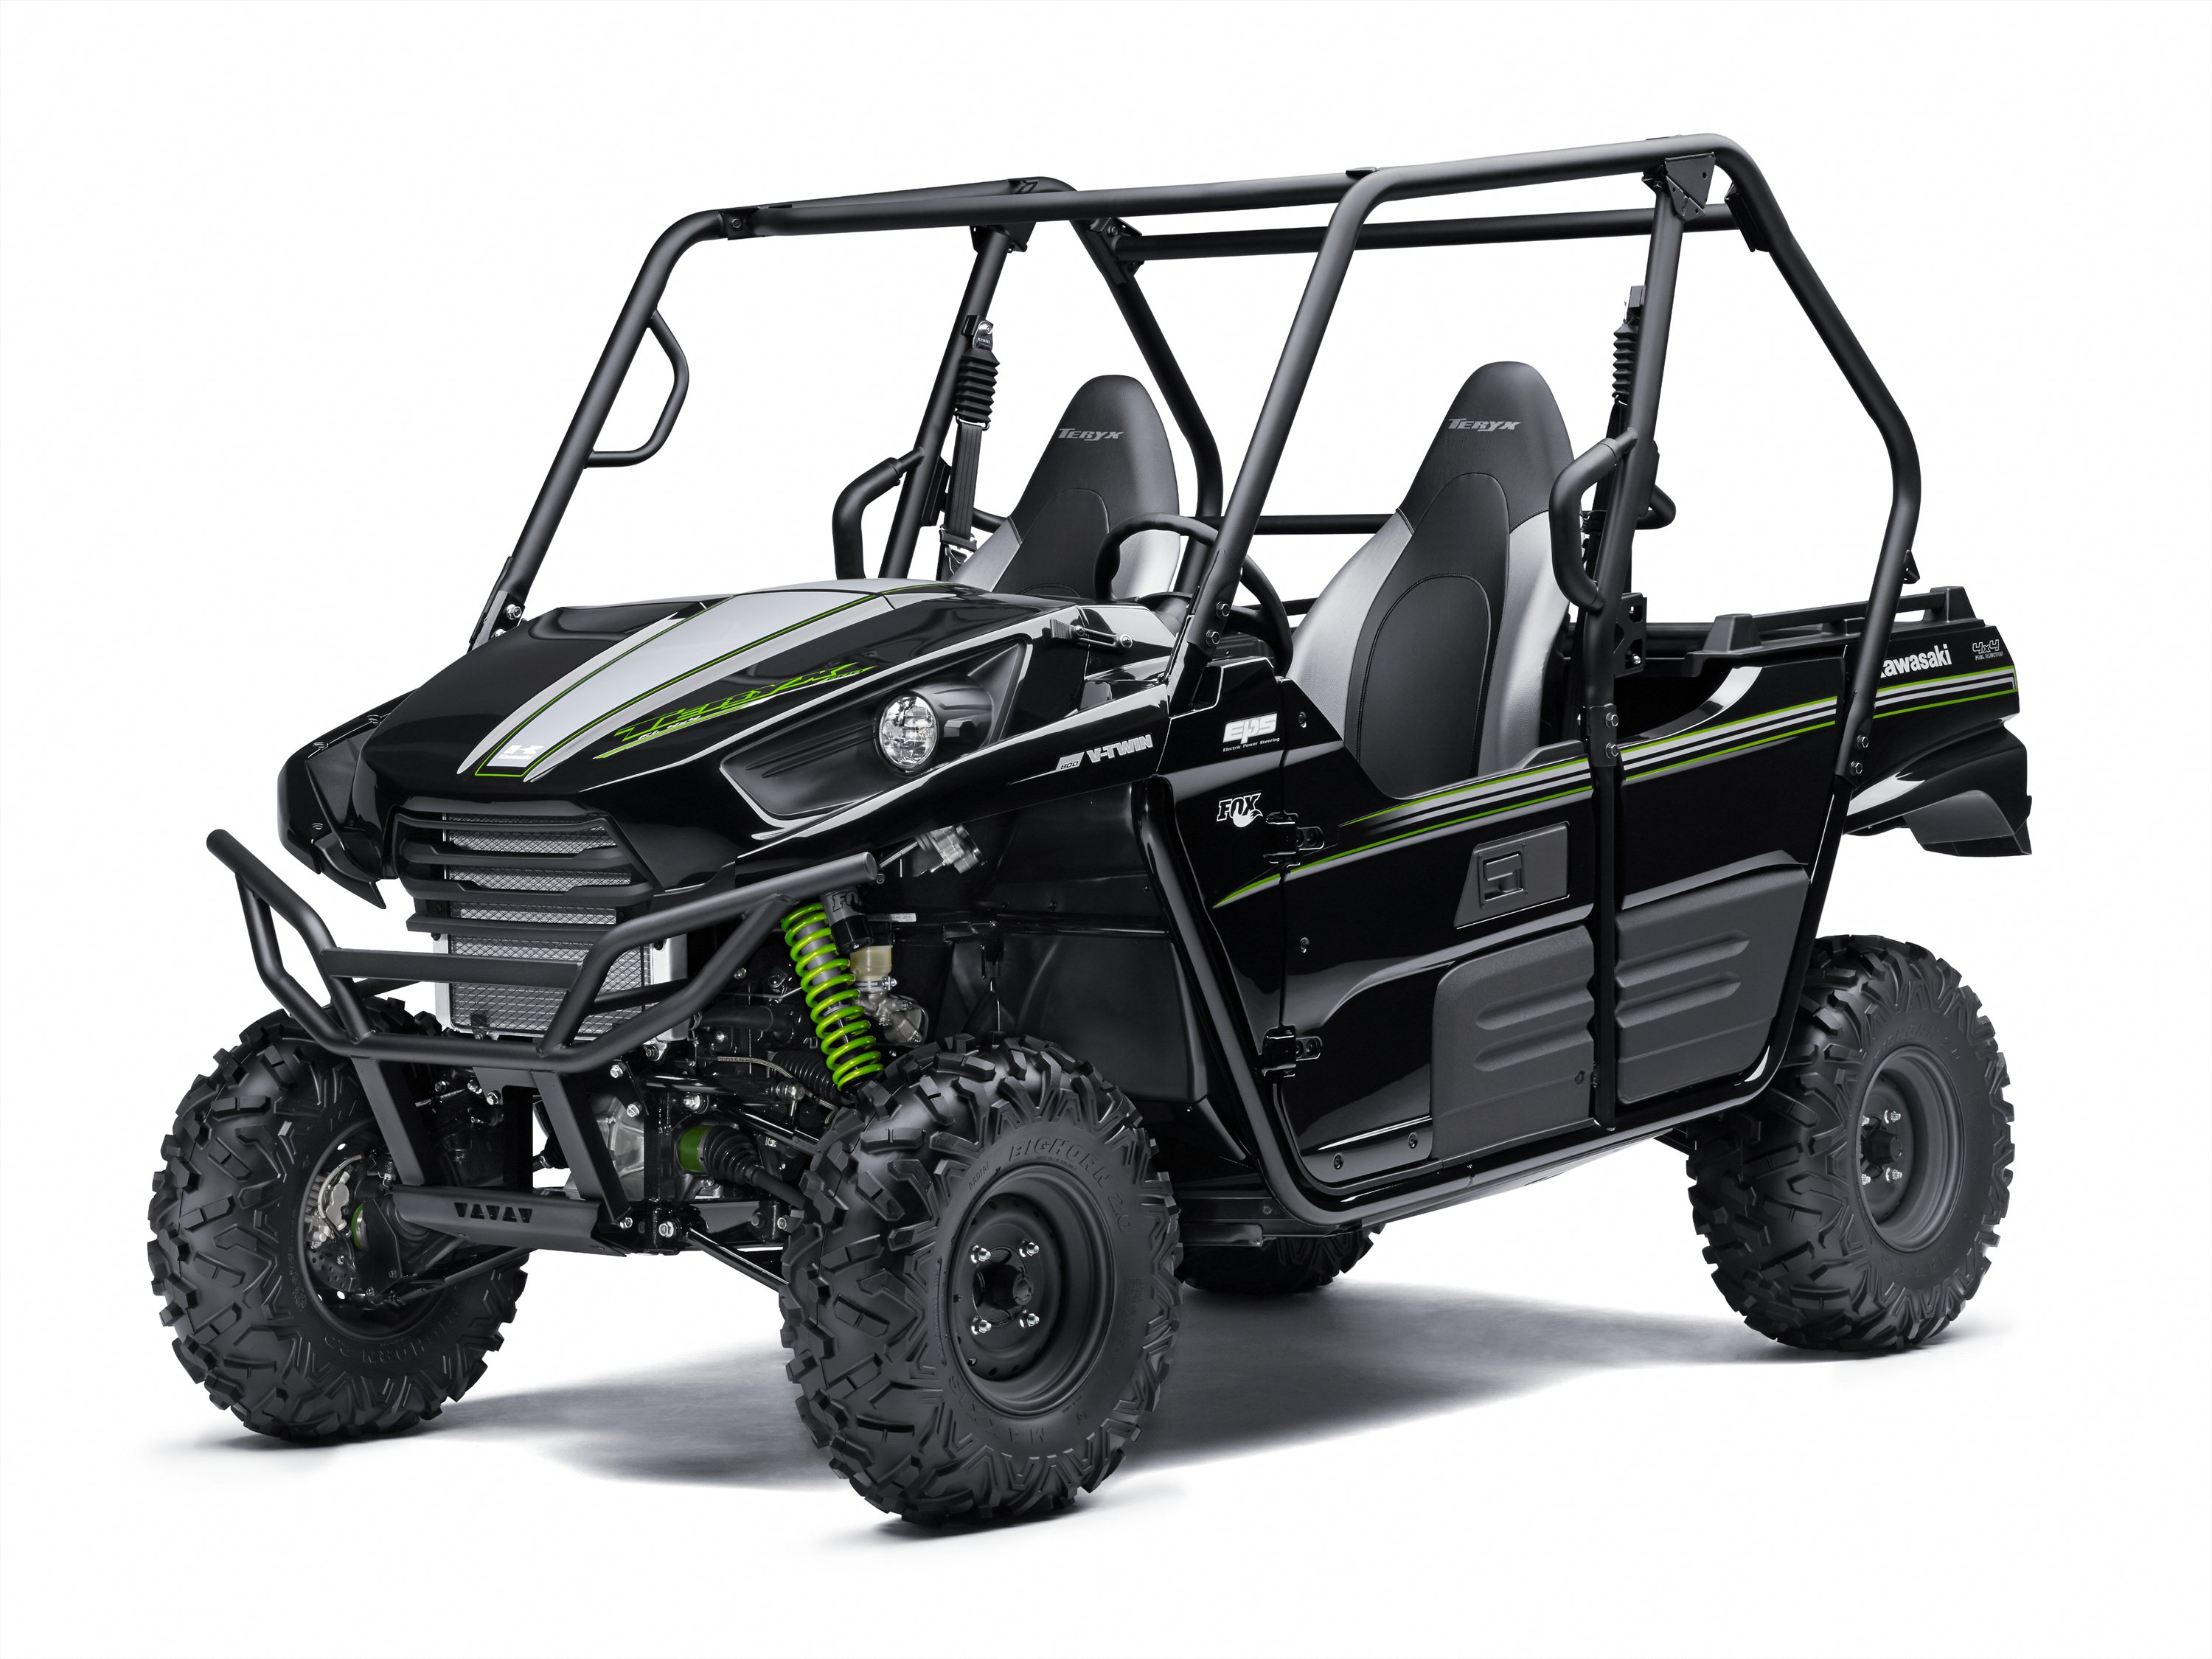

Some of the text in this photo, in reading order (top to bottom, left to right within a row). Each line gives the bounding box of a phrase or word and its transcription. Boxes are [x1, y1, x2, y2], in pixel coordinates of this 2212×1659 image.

[1972, 639, 1999, 654] 4x4
[1222, 713, 1277, 745] EPS
[1060, 734, 1153, 769] 800 V-TWIN
[1217, 793, 1262, 821] FOX
[1008, 1137, 1112, 1188] BIGHORN
